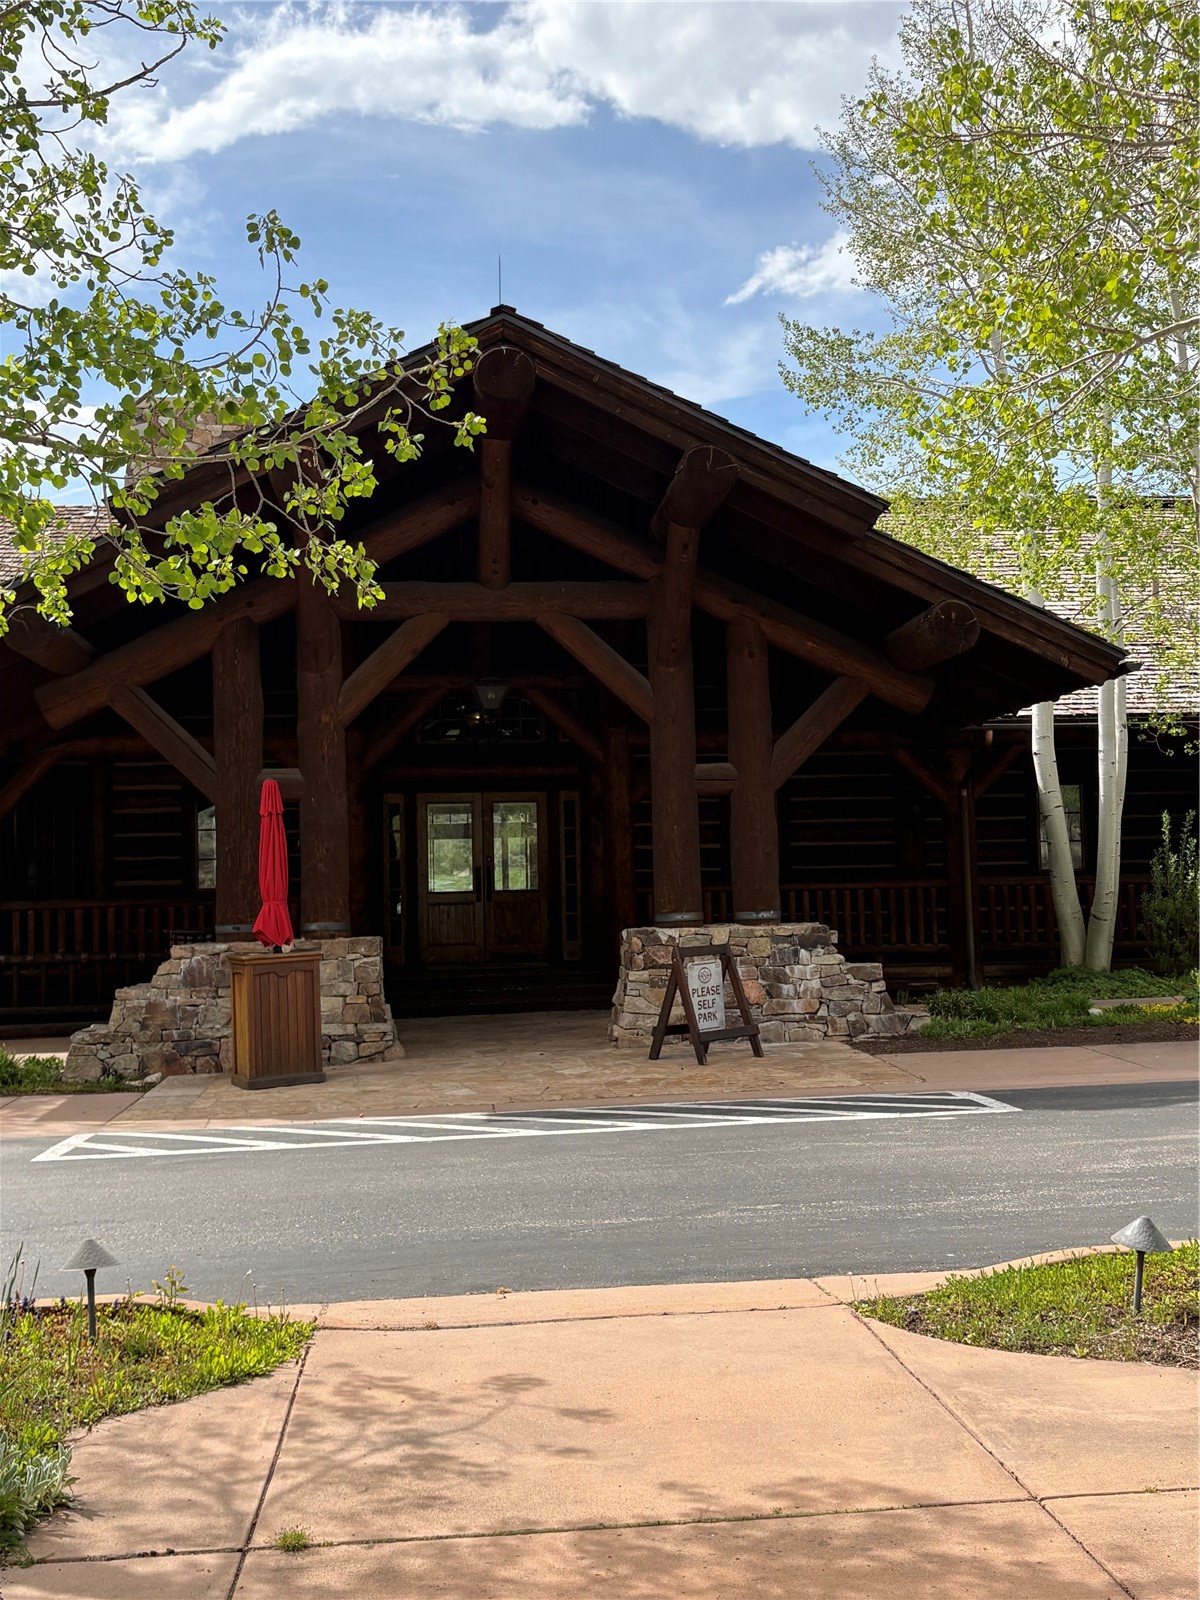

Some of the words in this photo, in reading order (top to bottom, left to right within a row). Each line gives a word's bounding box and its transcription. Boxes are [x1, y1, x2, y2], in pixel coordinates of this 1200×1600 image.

[691, 985, 721, 998] PLEASE
[697, 998, 716, 1011] SELF
[698, 1011, 718, 1024] PARK
